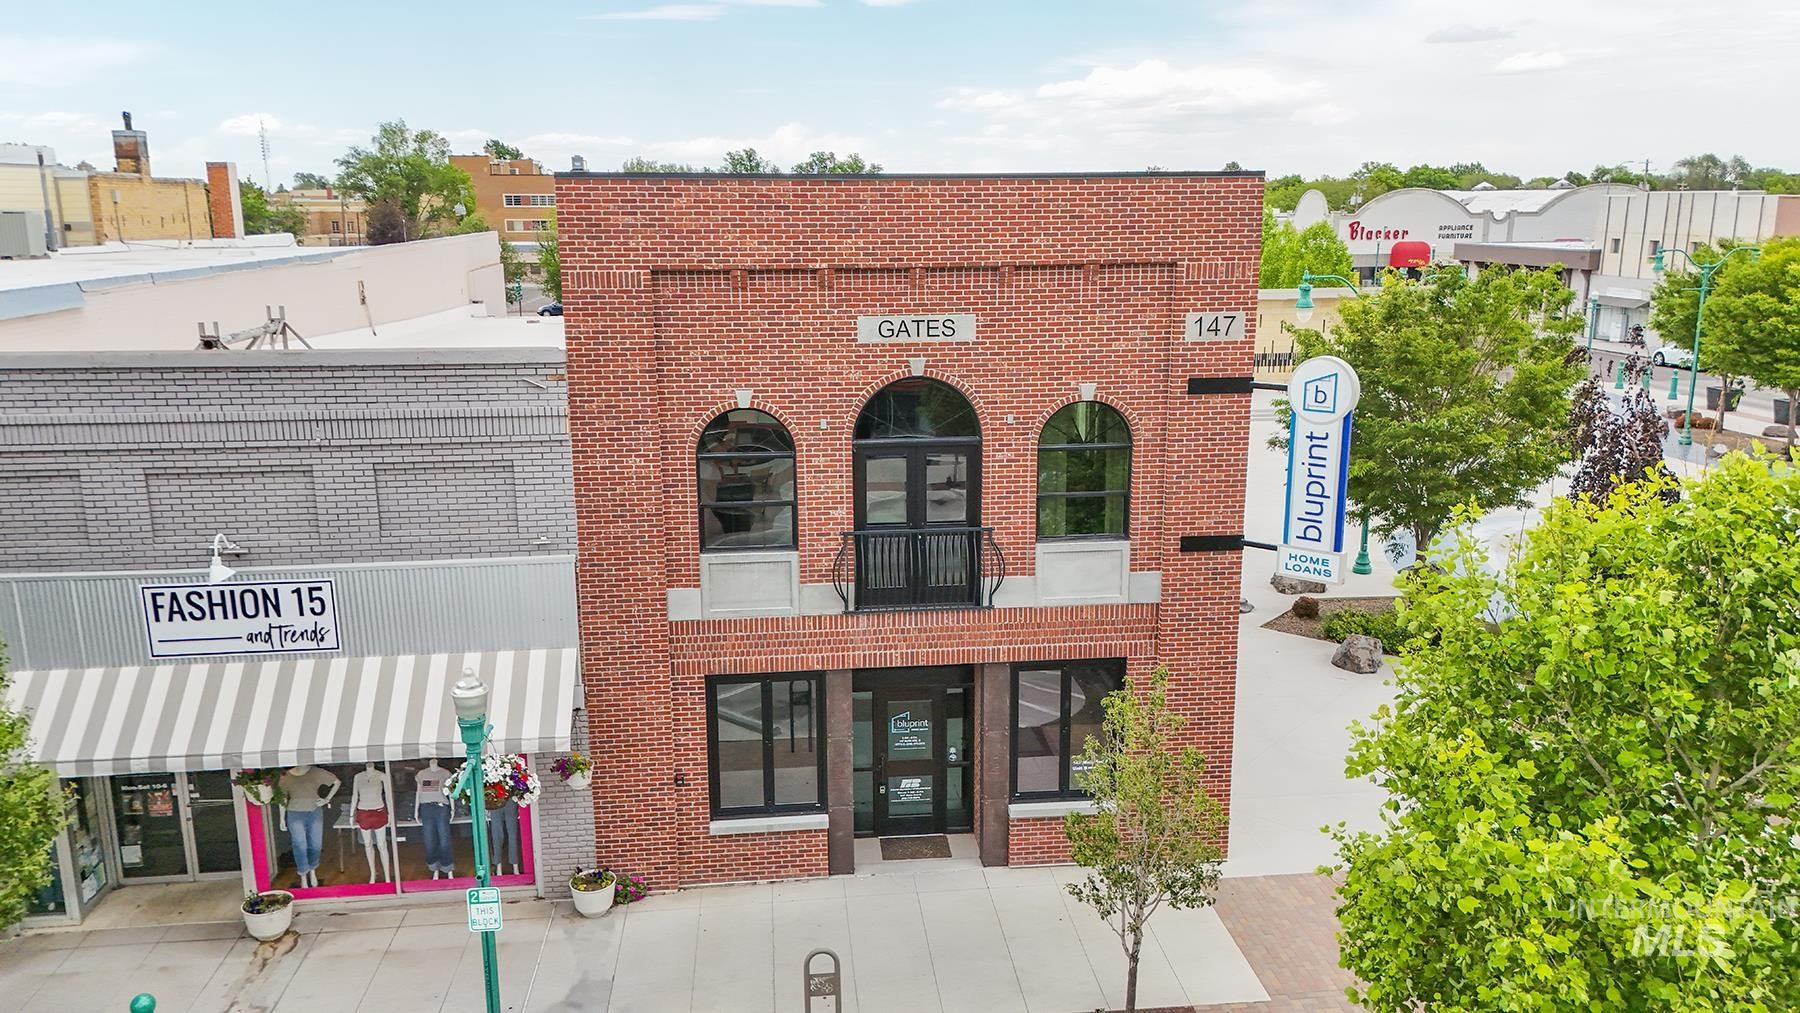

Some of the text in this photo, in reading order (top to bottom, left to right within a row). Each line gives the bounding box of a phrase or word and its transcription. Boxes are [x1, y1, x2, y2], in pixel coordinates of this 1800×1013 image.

[1349, 220, 1409, 240] Blacker
[878, 318, 956, 338] GATES
[1194, 315, 1237, 337] 147
[1296, 431, 1331, 543] bluprint
[1288, 553, 1330, 568] HOME
[1285, 564, 1332, 578] LOANS
[150, 586, 326, 623] FASHION 15
[246, 621, 331, 649] and Trends
[897, 719, 929, 728] bluprint
[470, 891, 479, 902] 2
[476, 907, 494, 915] THIS
[472, 918, 499, 926] BLOCK
